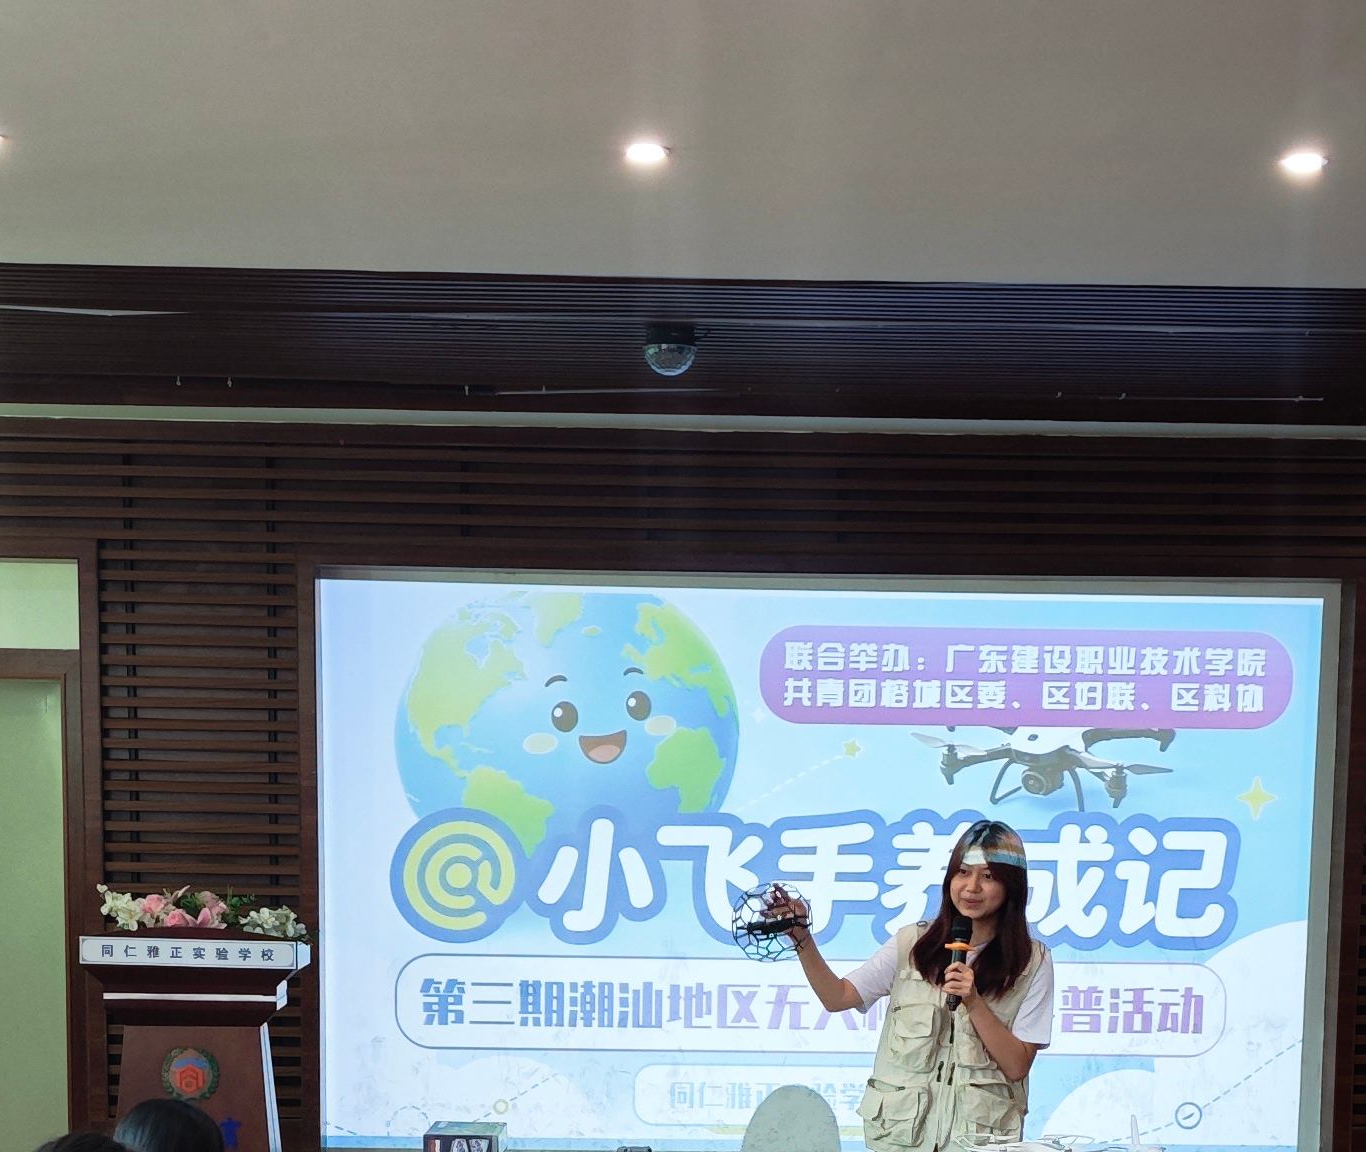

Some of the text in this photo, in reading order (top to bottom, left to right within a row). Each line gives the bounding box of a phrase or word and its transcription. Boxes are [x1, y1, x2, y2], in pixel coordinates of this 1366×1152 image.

[101, 944, 275, 962] 同仁雅正实验学校
